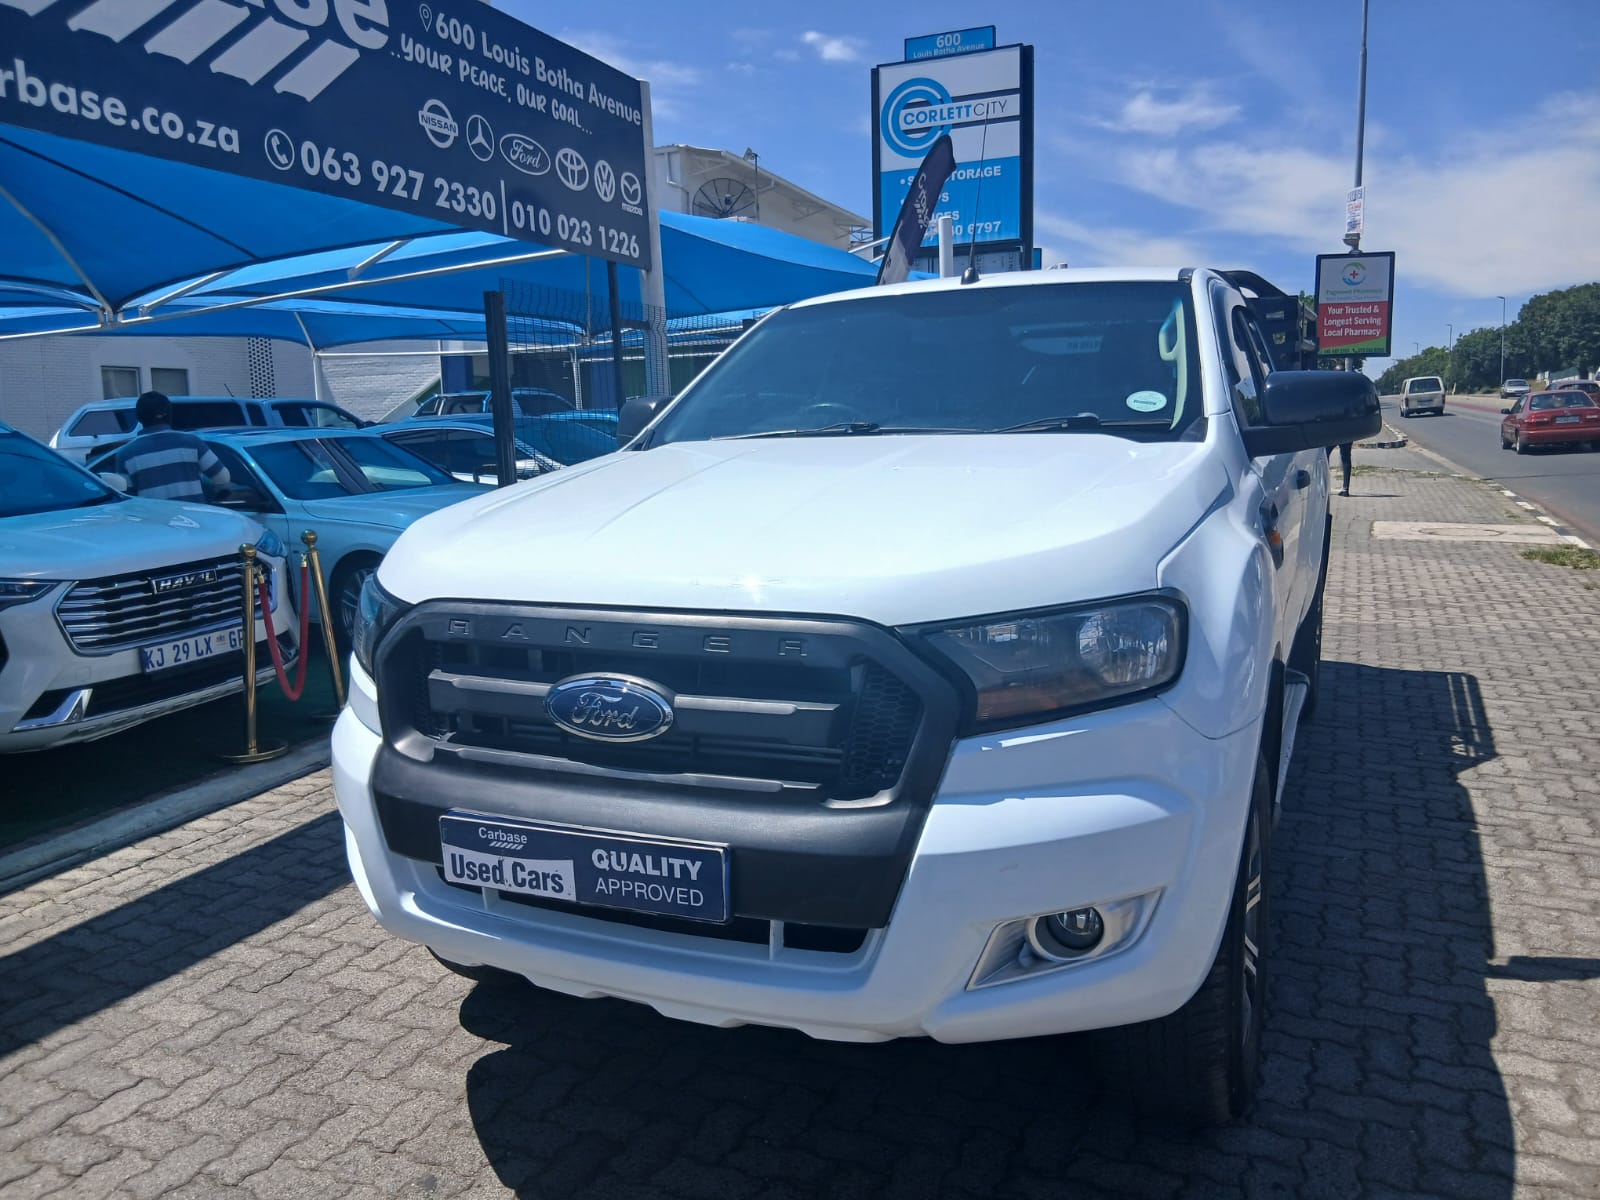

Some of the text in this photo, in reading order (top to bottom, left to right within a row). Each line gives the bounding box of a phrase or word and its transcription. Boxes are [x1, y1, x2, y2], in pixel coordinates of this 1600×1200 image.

[913, 43, 985, 59] Louis Botha Avenue
[936, 33, 961, 48] 600
[435, 12, 475, 50] 600
[482, 31, 530, 75] Louis
[535, 56, 584, 100] Botha
[588, 82, 642, 126] Avenue
[459, 58, 512, 103] PEACE,
[516, 83, 547, 114] OUR
[420, 113, 457, 134] NISSAN
[509, 139, 541, 169] Ford
[945, 165, 1002, 183] TORAGE
[300, 140, 639, 259] 063 927 2330 010 023 1226
[968, 221, 1001, 235] 6797
[1324, 317, 1382, 327] Longest Serving
[1328, 304, 1379, 315] Your Trusted &
[1324, 327, 1381, 337] Local Pharmacy
[447, 617, 808, 657] RANGER
[145, 647, 165, 669] KJ
[173, 642, 190, 664] 29
[195, 636, 213, 657] LX
[570, 691, 639, 731] Ford
[478, 826, 528, 844] Carbase
[450, 852, 565, 894] Used Cars
[591, 848, 702, 881] QUALITY
[595, 877, 704, 907] APPROVED
